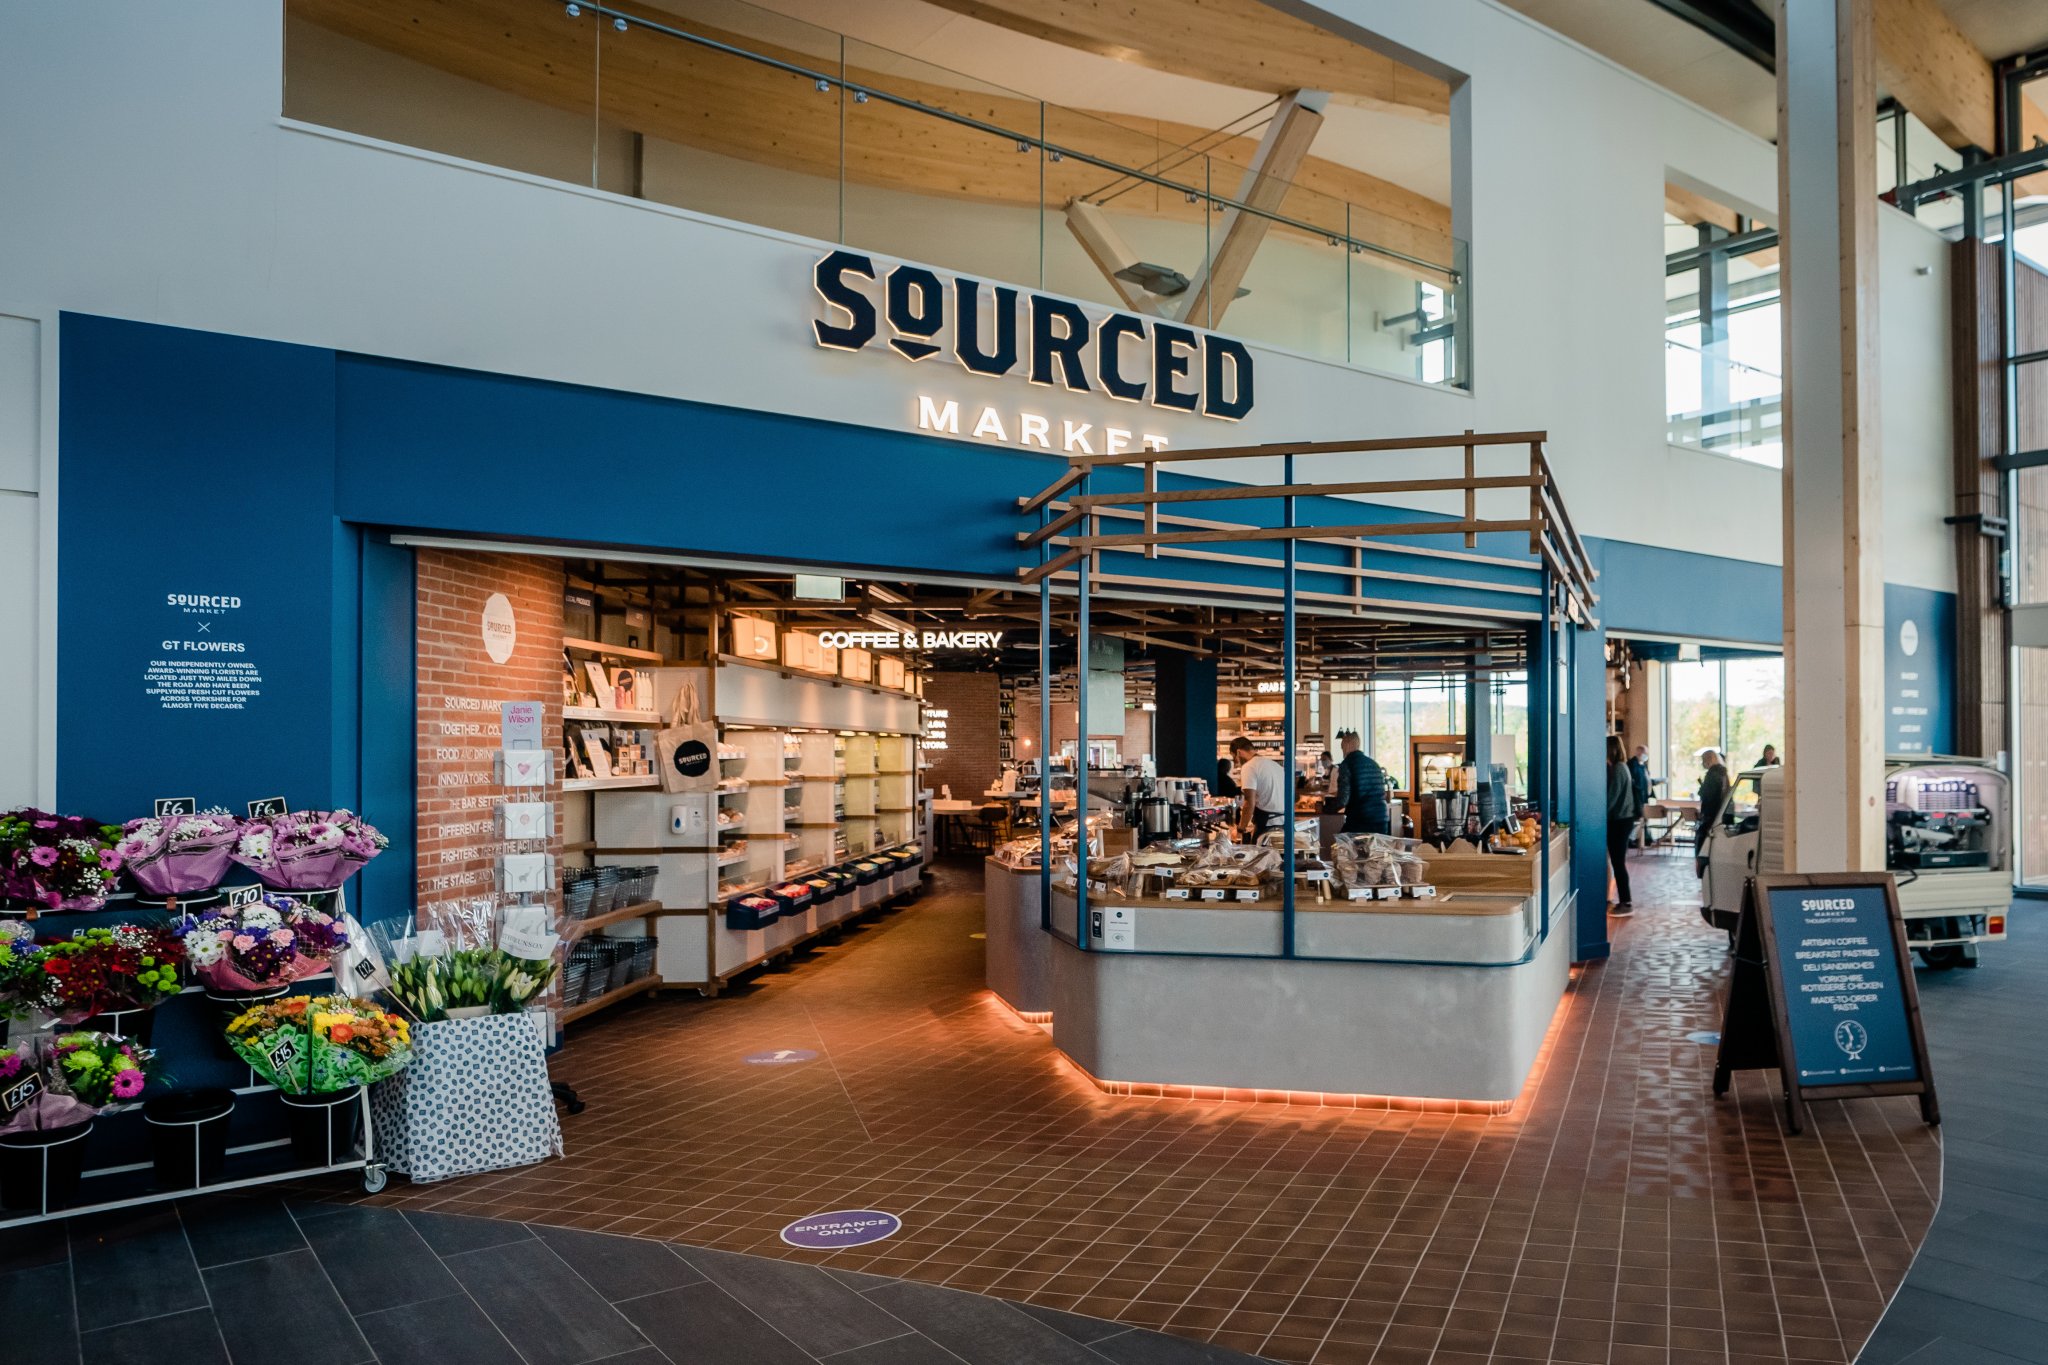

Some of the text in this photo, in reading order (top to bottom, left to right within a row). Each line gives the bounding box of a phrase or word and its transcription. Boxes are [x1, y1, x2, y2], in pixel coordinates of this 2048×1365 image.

[812, 249, 1255, 423] SOURCED
[917, 396, 1169, 456] MARKET
[167, 594, 242, 608] SOURCED
[162, 640, 246, 653] GT FLOWERS
[818, 631, 1003, 649] COFFEE & BAKERY
[444, 696, 480, 711] SOURCED
[511, 706, 533, 715] Janie
[508, 715, 535, 724] Wilson
[437, 749, 460, 760] FOOD
[679, 752, 707, 765] SOURCED
[162, 801, 185, 816] £6
[461, 797, 477, 809] BAR
[254, 802, 276, 818] £6
[431, 877, 449, 890] THE
[233, 888, 258, 908] £10
[1801, 898, 1855, 911] SOURCED
[1801, 937, 1869, 946] ARTISAN COFFEE
[1795, 948, 1880, 960] BREAKFAST PASTRIES
[1802, 961, 1875, 972] DELI SANDWICHES
[1818, 974, 1864, 983] YORKSHIRE
[1801, 981, 1884, 993] ROTISSERIE CHICKEN
[1811, 993, 1879, 1005] MADE-TO-ORDER
[1833, 1003, 1859, 1012] PASTA
[275, 1043, 292, 1067] £15
[11, 1079, 35, 1108] £15
[795, 1219, 889, 1232] ENTRANCE
[818, 1227, 865, 1236] ONLY
